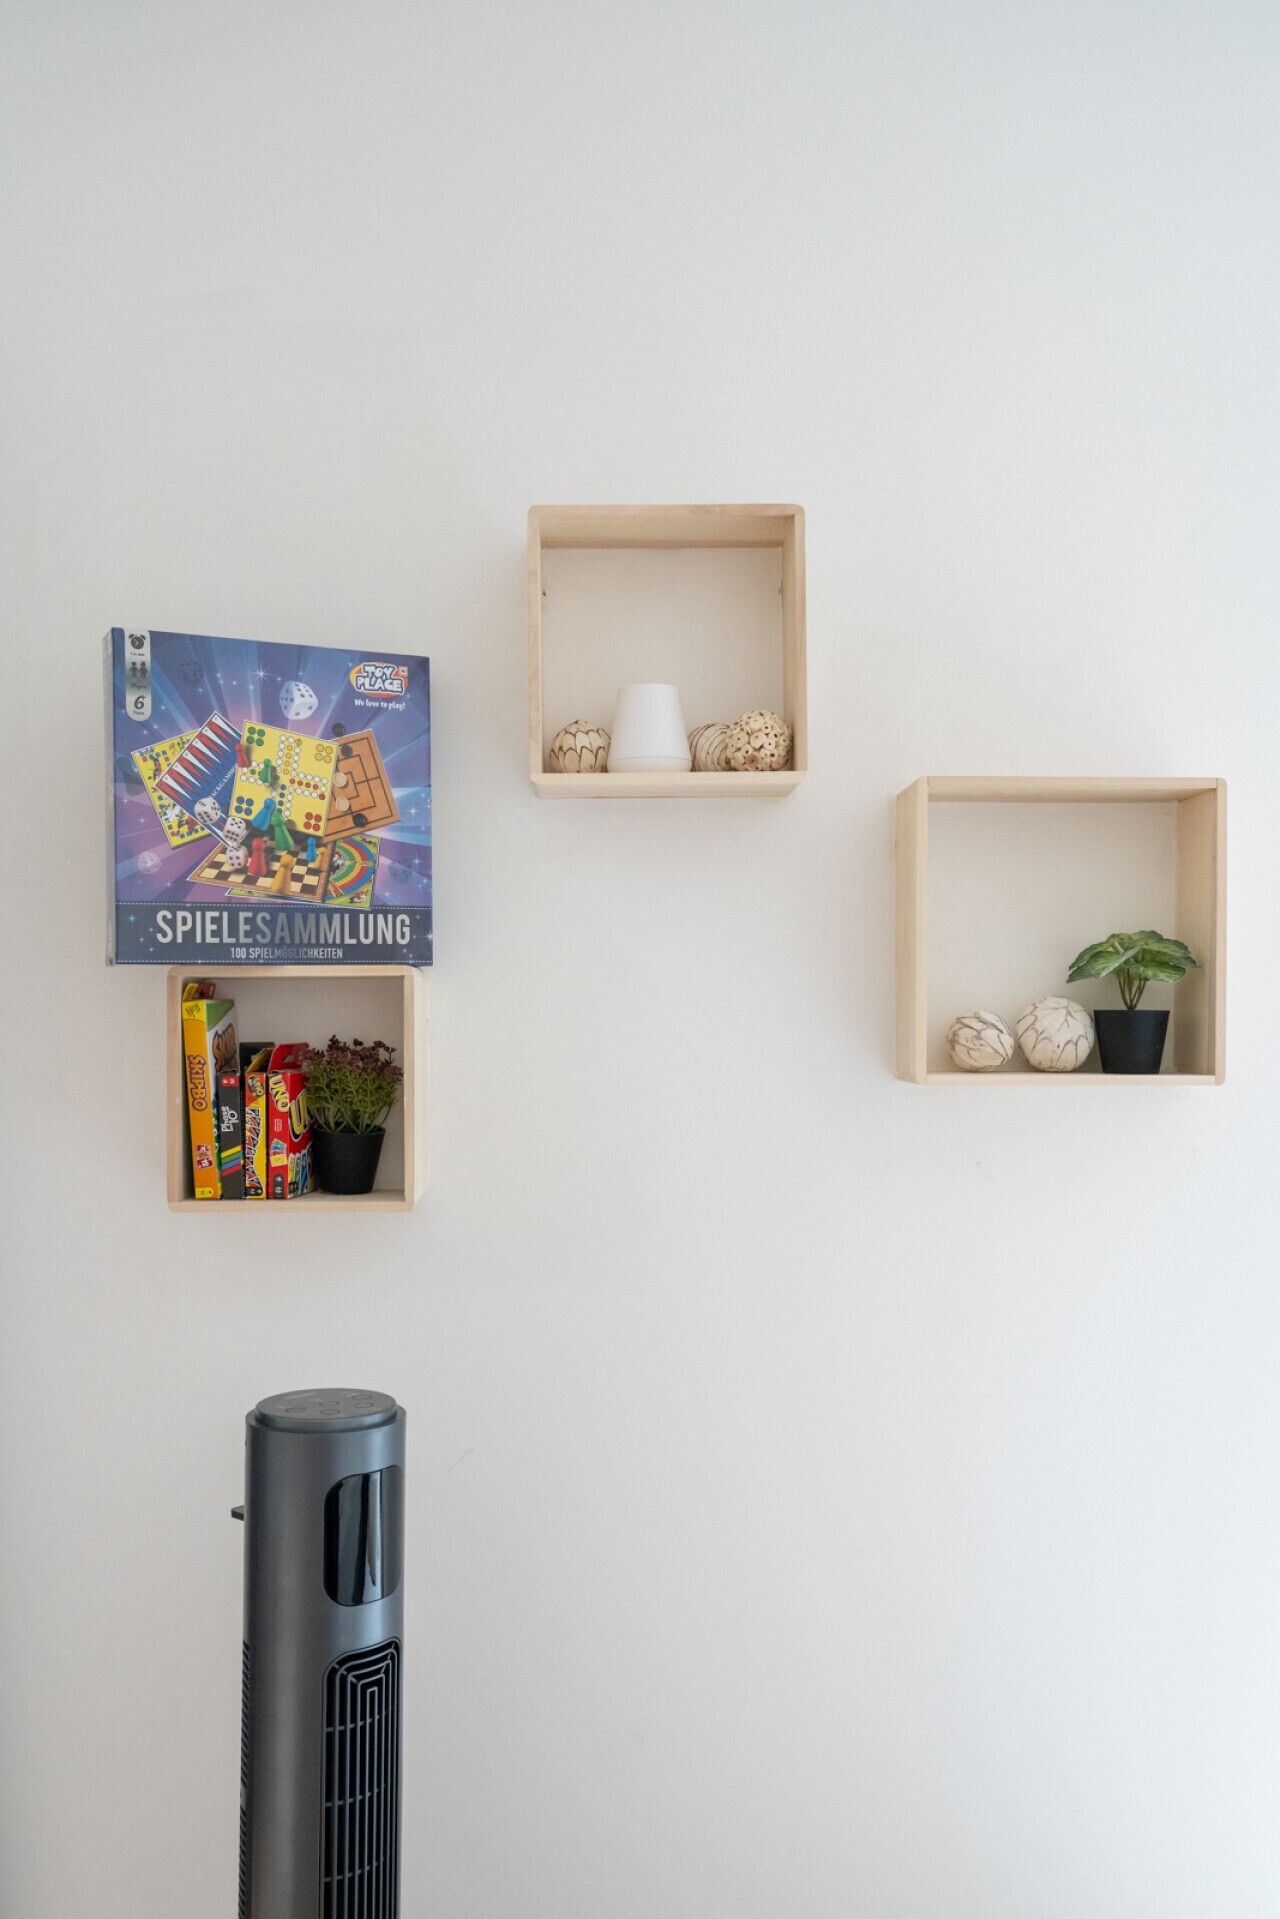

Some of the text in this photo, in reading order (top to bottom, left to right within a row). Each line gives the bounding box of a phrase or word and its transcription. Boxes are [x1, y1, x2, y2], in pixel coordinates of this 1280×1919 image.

[363, 665, 396, 680] TOY
[356, 676, 403, 692] PLACE
[354, 698, 365, 706] We
[366, 699, 380, 708] love
[388, 701, 406, 711] play!
[155, 910, 411, 945] SPIELESAMMLUNG
[230, 946, 343, 959] 100 SPIELMÖGLICHKEITEN
[269, 1071, 290, 1113] UNO
[221, 1105, 233, 1132] Phase
[228, 1110, 239, 1124] 10
